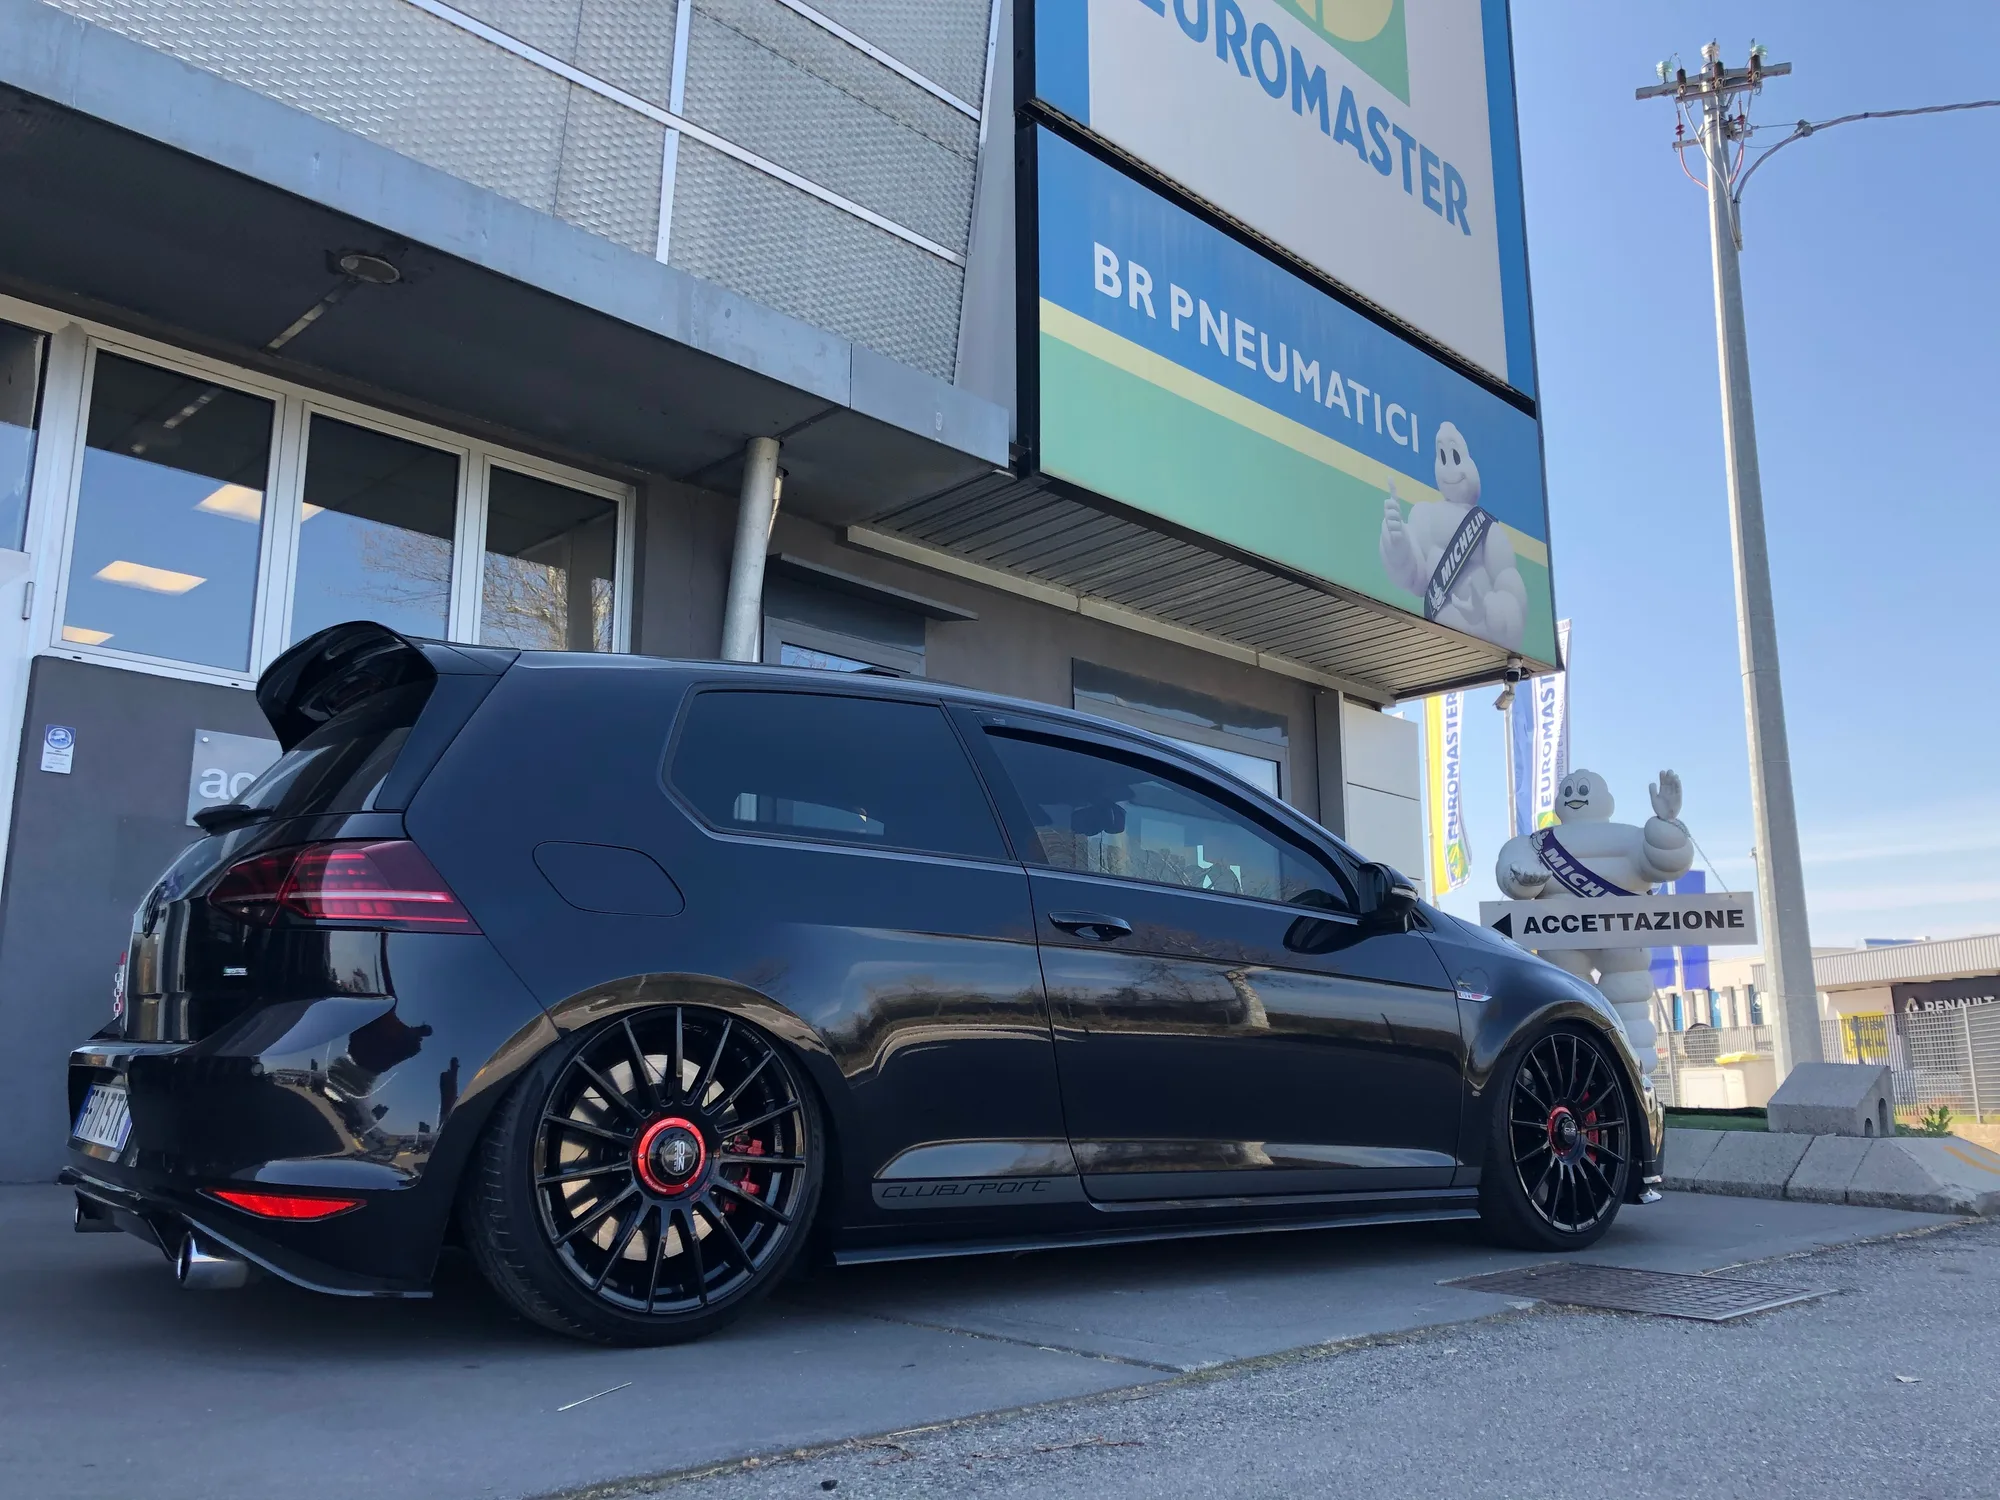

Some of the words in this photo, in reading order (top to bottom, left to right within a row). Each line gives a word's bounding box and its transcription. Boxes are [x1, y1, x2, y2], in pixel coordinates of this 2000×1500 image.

[1138, 0, 1472, 236] UROMASTER
[1094, 241, 1156, 319] BR
[1170, 283, 1419, 453] PNEUMATICI
[1441, 511, 1486, 586] MICHELIN
[1544, 848, 1618, 897] MICH
[1524, 910, 1744, 934] ACCETTAZIONE
